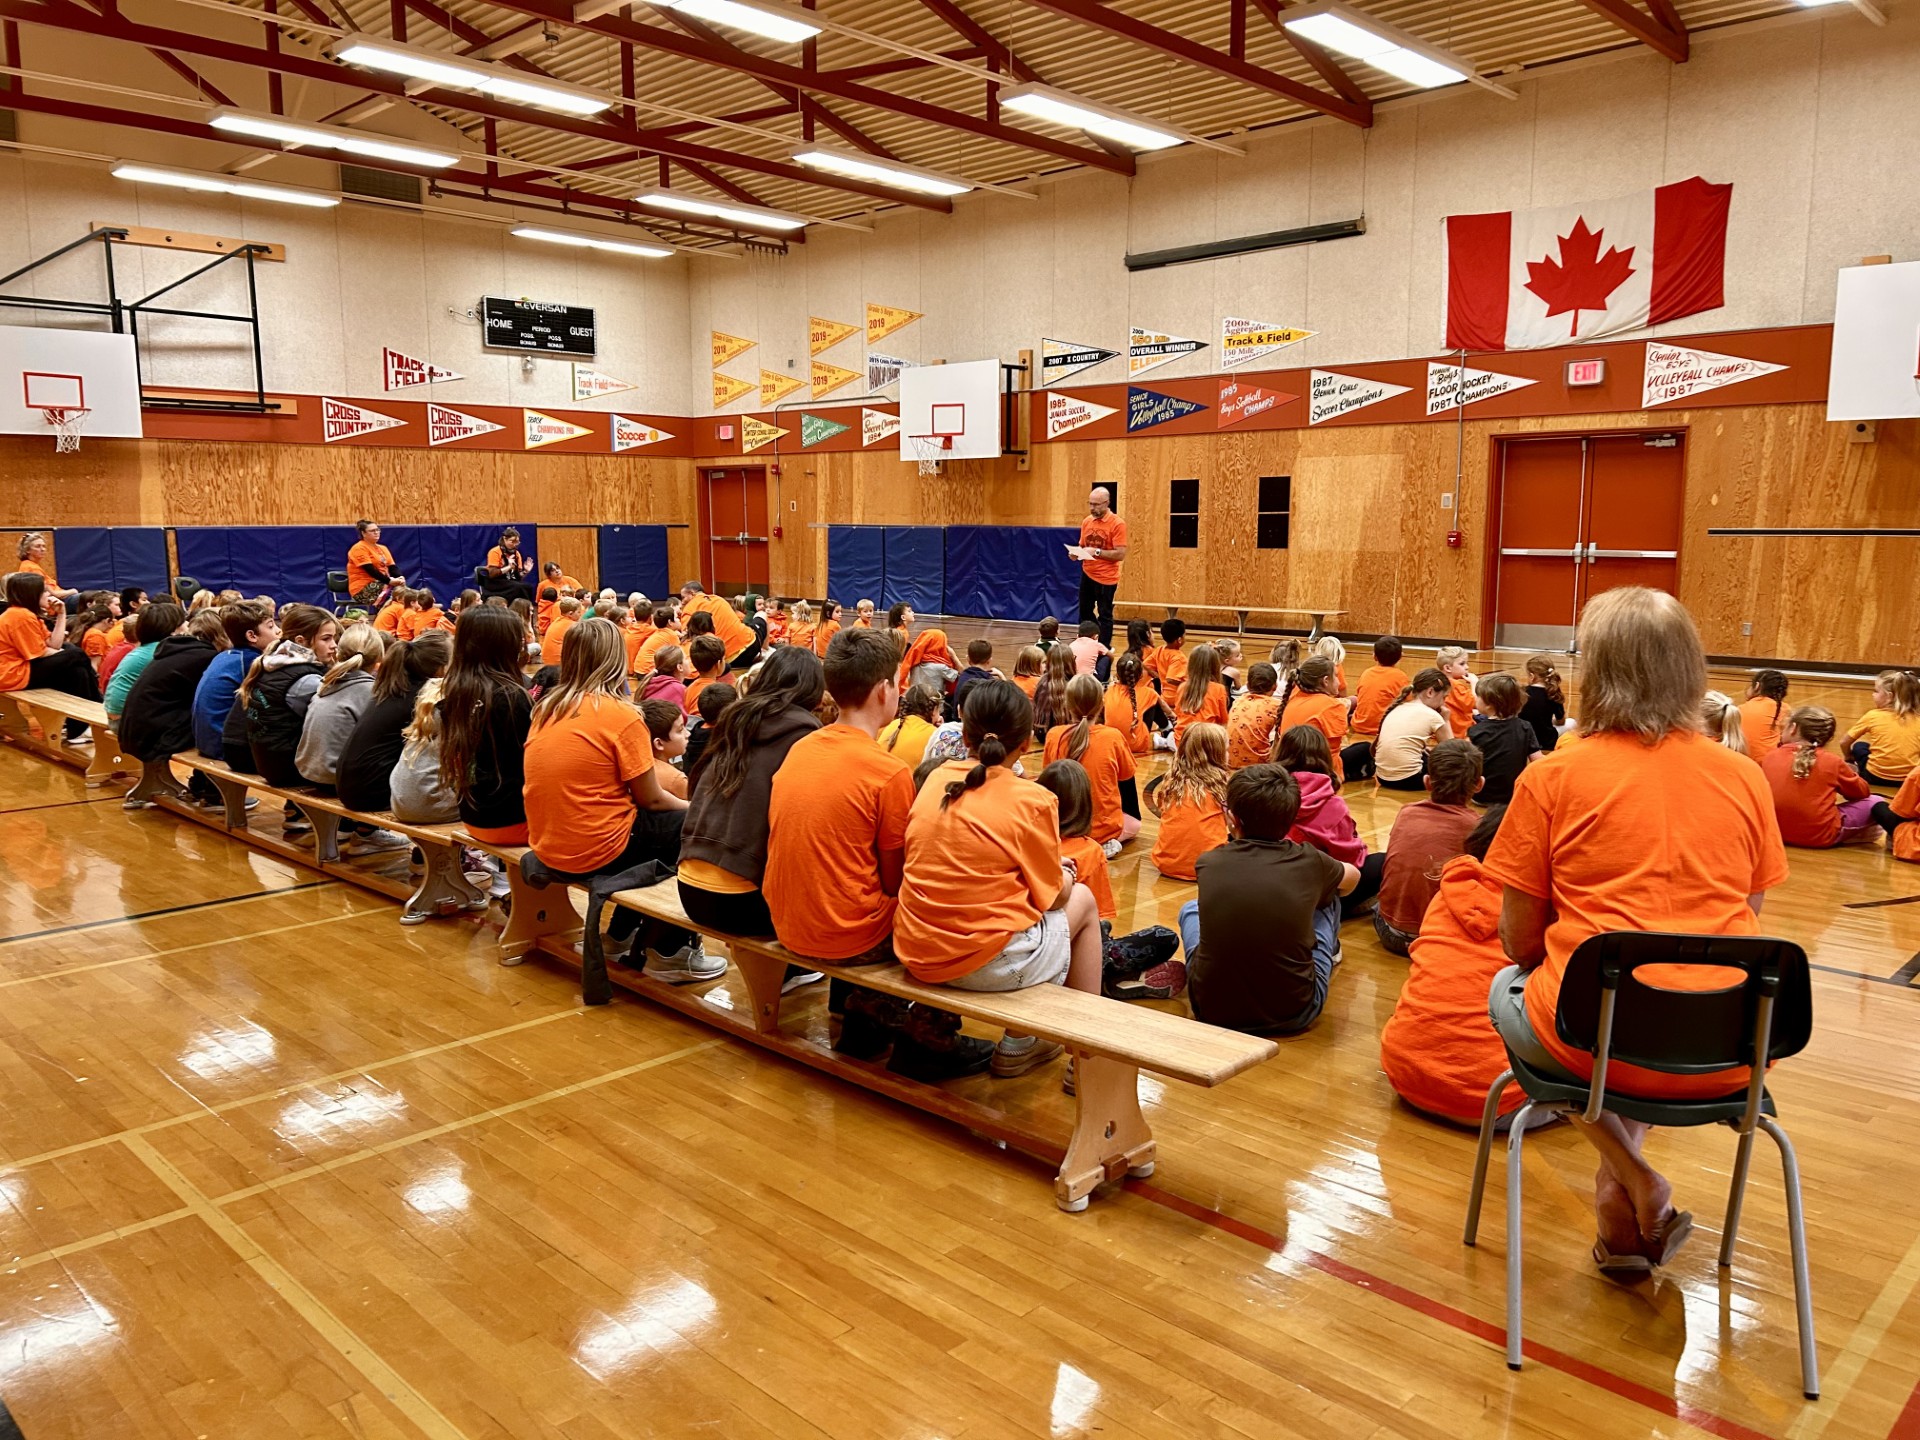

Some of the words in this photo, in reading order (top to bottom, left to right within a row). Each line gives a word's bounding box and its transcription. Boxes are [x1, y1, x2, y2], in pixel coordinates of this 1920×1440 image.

[487, 318, 513, 329] HOME
[869, 318, 884, 329] 2019
[1224, 324, 1266, 334] Aggregate
[1225, 320, 1250, 328] 2008
[570, 326, 593, 337] GUEST
[812, 331, 826, 342] 2019
[1132, 335, 1152, 345] 150
[1227, 337, 1253, 346] Track
[1257, 335, 1263, 343] &
[1267, 332, 1290, 342] Field
[1130, 346, 1164, 355] OVERALL
[1165, 343, 1196, 352] WINNER
[389, 351, 424, 371] TRACK
[1072, 353, 1100, 362] COUNTRY
[1224, 352, 1262, 366] Elementary
[1648, 349, 1681, 365] Senior
[1666, 359, 1692, 369] BOYS
[395, 370, 426, 387] FIELD
[1437, 369, 1458, 384] Boys
[1574, 364, 1596, 382] EXIT
[1648, 369, 1702, 388] VOLLEYBALL
[1706, 362, 1749, 378] CHAMPS
[578, 377, 593, 389] Track
[813, 376, 828, 386] 2019
[1313, 376, 1333, 388] 1987
[715, 387, 727, 396] 2019
[762, 384, 775, 393] 2019
[1221, 384, 1238, 399] 1985
[1429, 383, 1458, 399] FLOOR
[1664, 383, 1694, 398] 1987
[1130, 392, 1148, 404] SENIOR
[1430, 398, 1451, 412] 1987
[1455, 382, 1508, 404] CHAMPIONS
[1050, 399, 1066, 409] 1985
[1132, 399, 1154, 411] GIRLS
[1221, 402, 1234, 417] Boys
[1244, 396, 1275, 416] CHAMPS
[1312, 404, 1338, 421] Soccer
[1340, 389, 1382, 411] Champions
[325, 402, 360, 420] CROSS
[431, 406, 462, 425] CROSS
[1049, 409, 1067, 419] JUNIOR
[1069, 406, 1085, 415] SOCCER
[1130, 398, 1168, 428] Volleyball
[1167, 398, 1196, 414] Champs
[1158, 410, 1174, 422] 1985
[527, 416, 544, 424] TRACK
[1052, 412, 1091, 432] Champions
[327, 420, 373, 438] COUNTRY
[432, 426, 473, 441] COUNTRY
[537, 425, 564, 434] CHAMPIONS
[864, 420, 880, 434] Soccer
[528, 434, 543, 442] FIELD
[617, 428, 647, 441] Soccer
[868, 432, 881, 443] 1984
